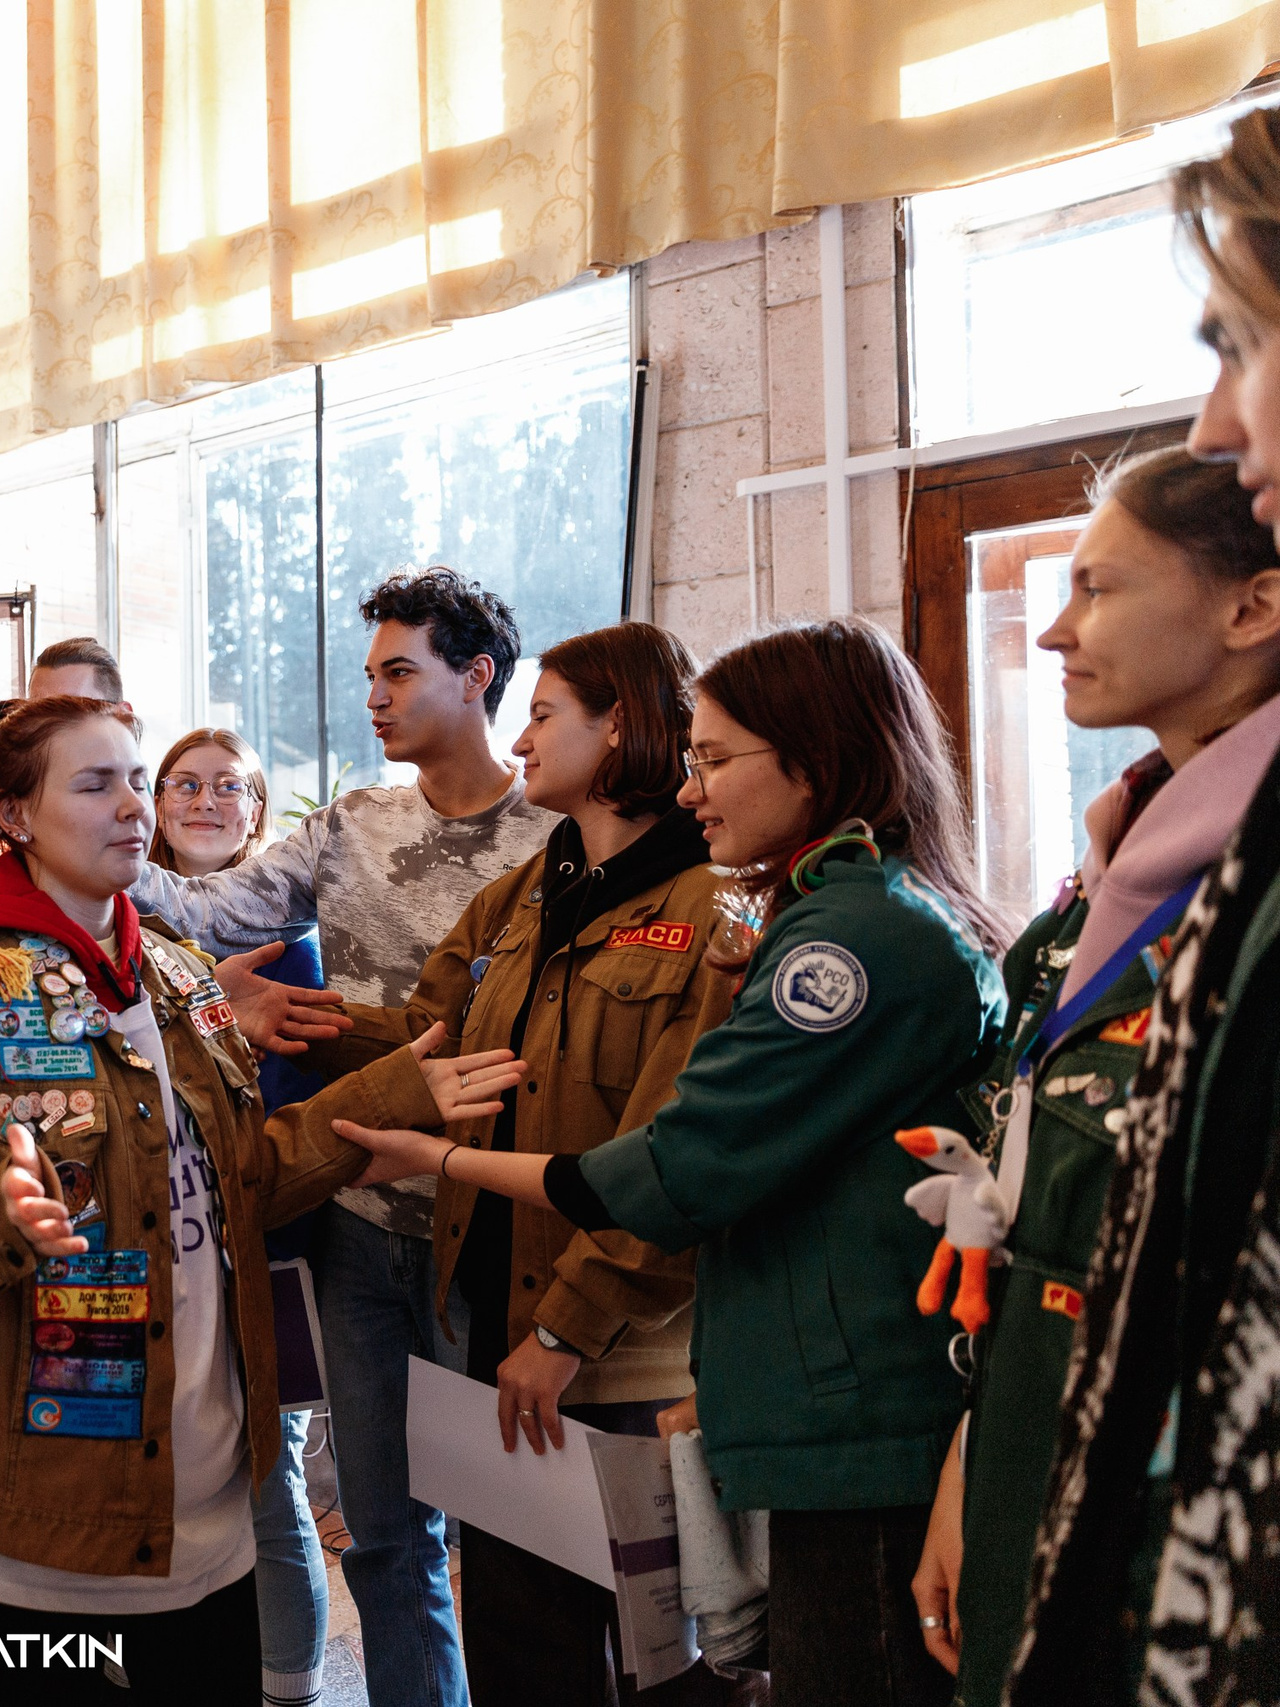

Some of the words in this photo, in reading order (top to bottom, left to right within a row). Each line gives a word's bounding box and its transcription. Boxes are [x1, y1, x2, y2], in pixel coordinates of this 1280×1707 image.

[823, 968, 850, 986] РСО
[79, 1292, 96, 1303] ДОЛ
[112, 1304, 129, 1315] 2019
